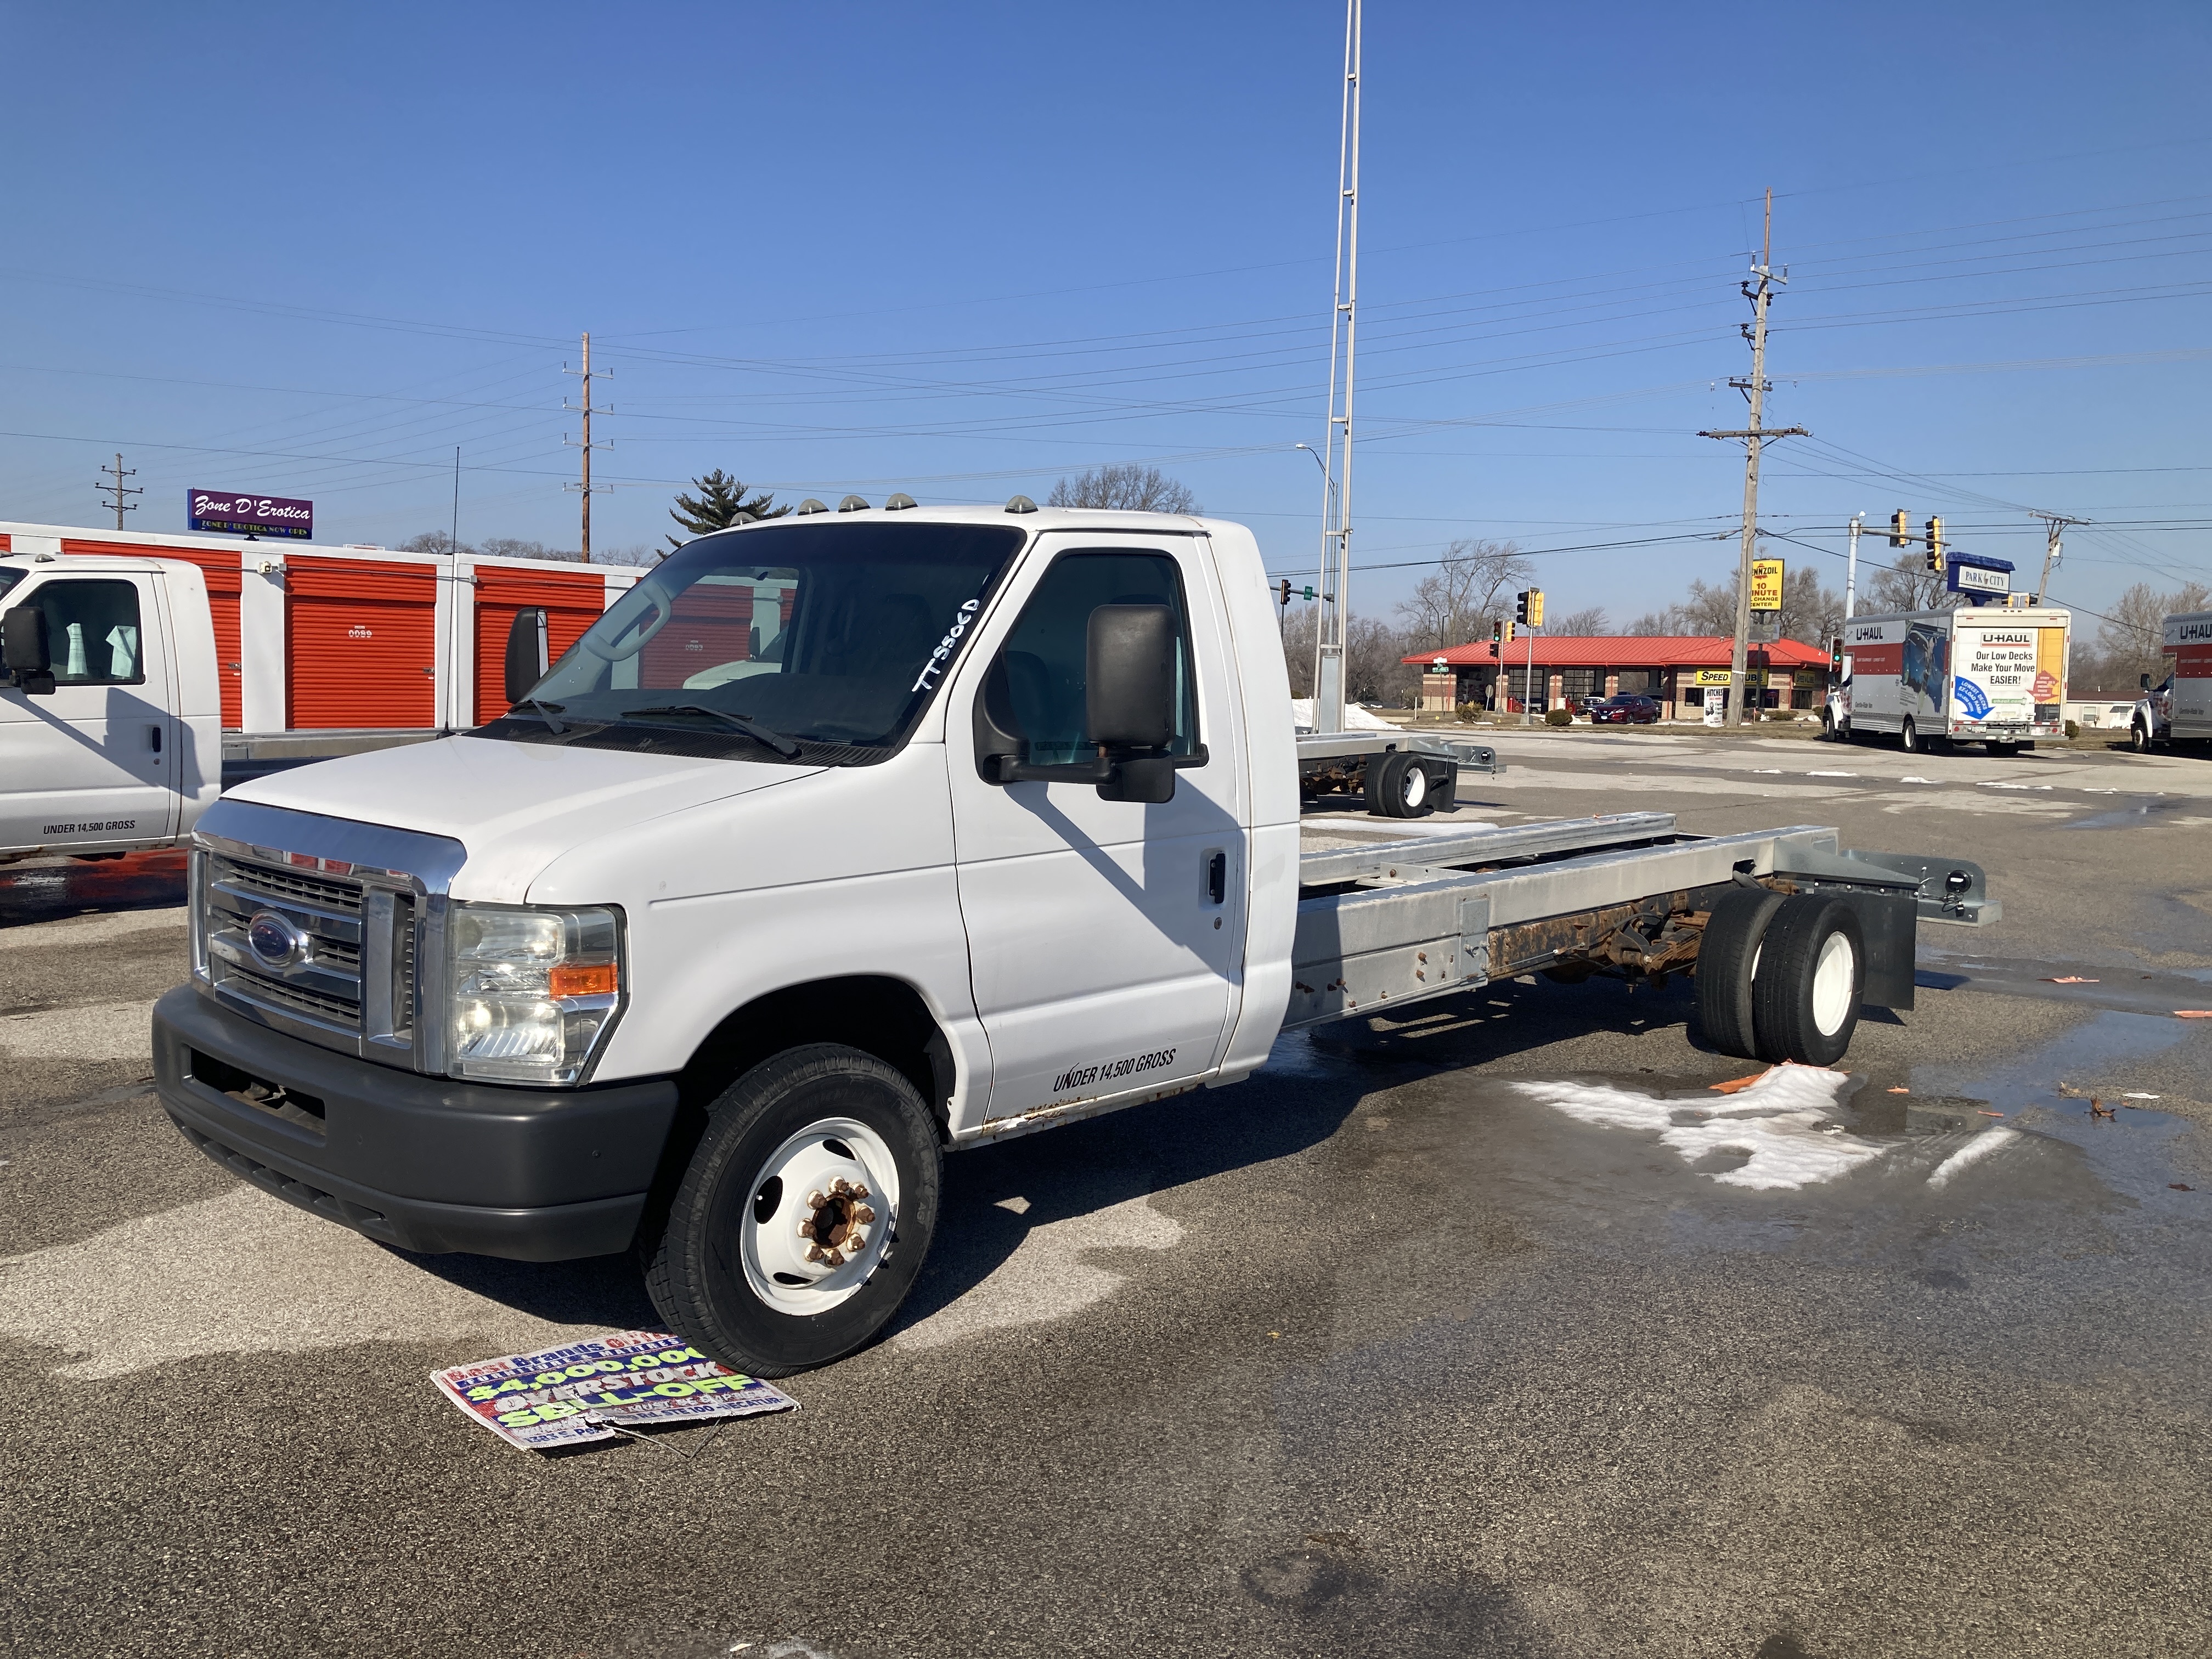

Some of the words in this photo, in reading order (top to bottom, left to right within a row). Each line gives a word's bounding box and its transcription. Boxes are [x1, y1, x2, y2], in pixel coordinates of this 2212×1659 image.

[195, 495, 231, 515] Zone
[235, 498, 311, 520] D'Erotica
[1752, 567, 1778, 576] NNZOIL
[1966, 571, 1982, 583] PARK
[1989, 575, 2005, 586] CITY
[1857, 627, 1883, 640] U-HAUL
[2180, 623, 2212, 640] U-HAU
[1976, 651, 1989, 660] Our
[1991, 651, 2007, 659] Low
[2009, 652, 2033, 660] Decks
[1971, 663, 1993, 672] Make
[1995, 663, 2012, 672] Your
[2015, 663, 2035, 672] Move
[1701, 671, 1728, 680] SPEED
[1990, 676, 2021, 684] EASIER!
[1707, 689, 1723, 697] HITCHES
[1959, 686, 1976, 701] EZ-LOAD
[1973, 700, 1982, 714] RAMP
[1961, 681, 1979, 694] LOWEST
[1977, 694, 1987, 710] DECKS
[43, 824, 75, 834] UNDER
[77, 822, 104, 832] 14,500
[105, 820, 136, 830] GROSS
[1053, 1066, 1098, 1092] UNDER
[1099, 1058, 1135, 1081] 14,500
[1136, 1048, 1176, 1073] GROSS
[447, 1361, 511, 1381] Best
[511, 1343, 605, 1367] Brands
[468, 1356, 574, 1385] FURNITURE
[599, 1338, 679, 1357] MATTRES
[661, 1406, 688, 1417] STE
[689, 1404, 714, 1414] 100
